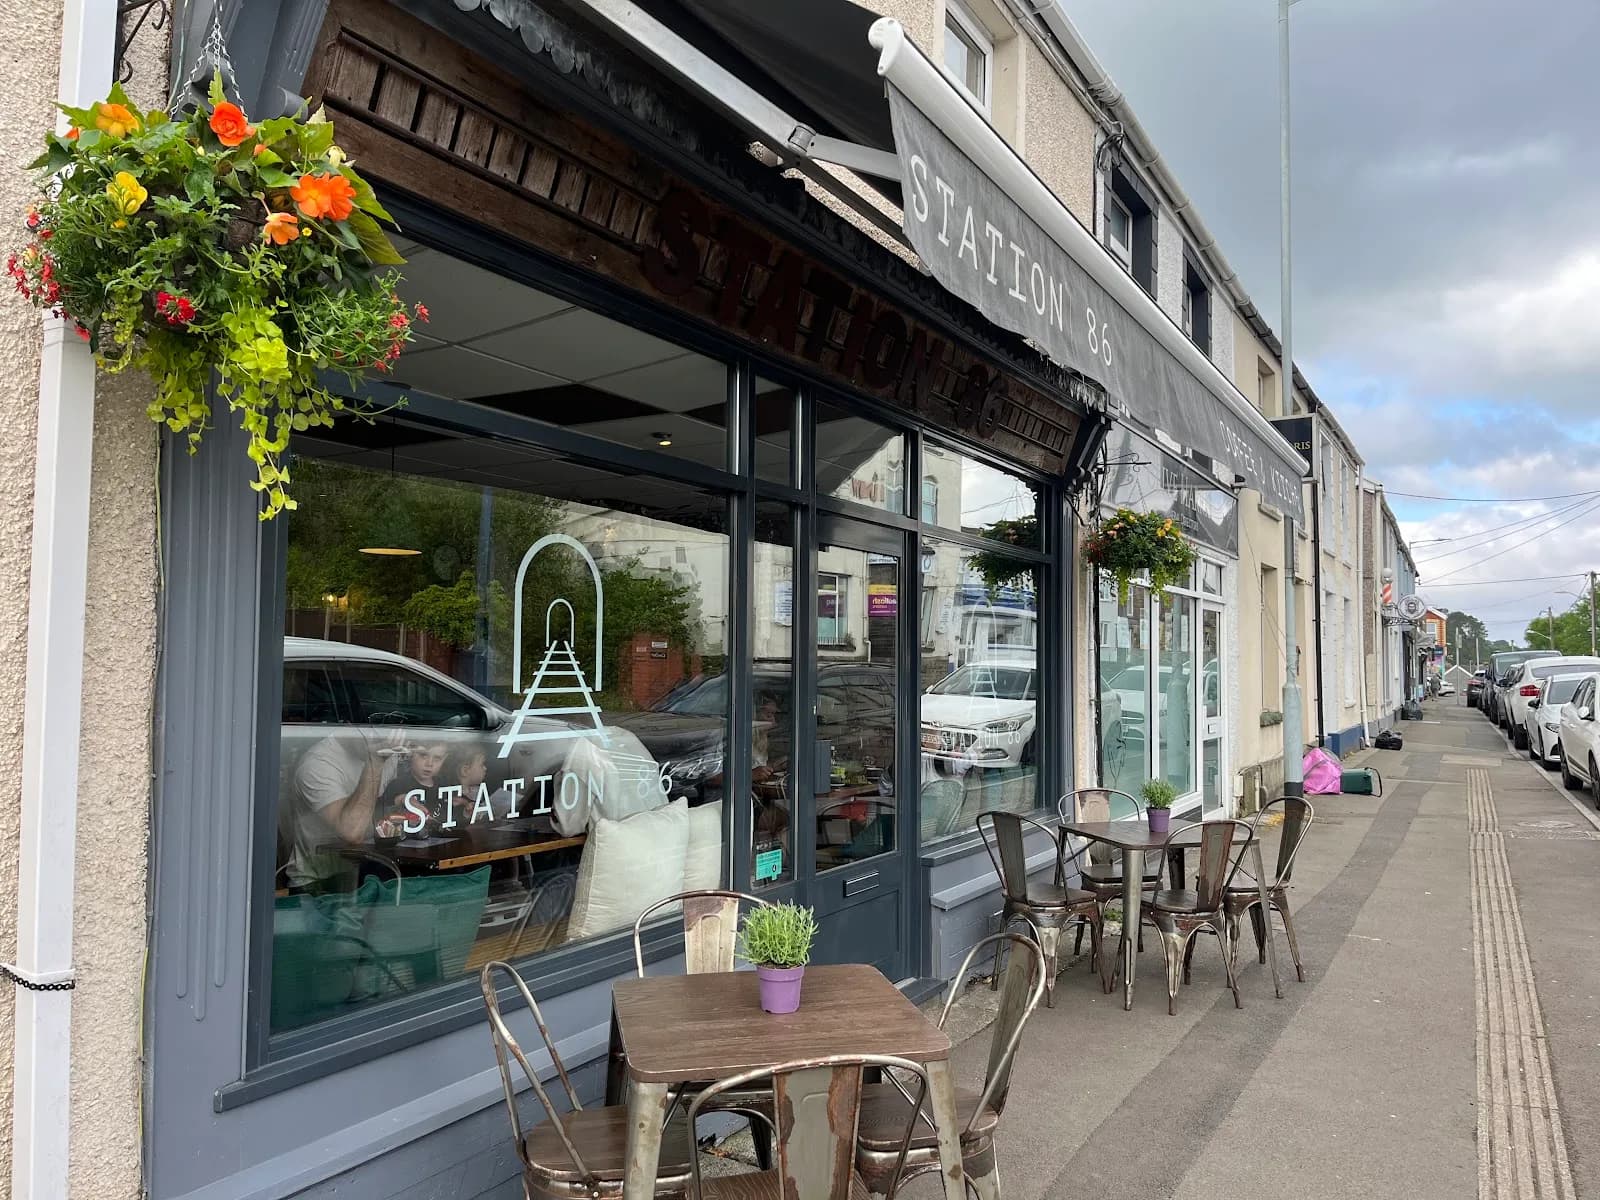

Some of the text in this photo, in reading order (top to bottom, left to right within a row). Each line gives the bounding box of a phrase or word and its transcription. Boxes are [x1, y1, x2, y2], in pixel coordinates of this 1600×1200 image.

[909, 153, 1112, 366] STATION 86
[1292, 440, 1311, 450] RIS
[402, 761, 673, 834] STATION 86
